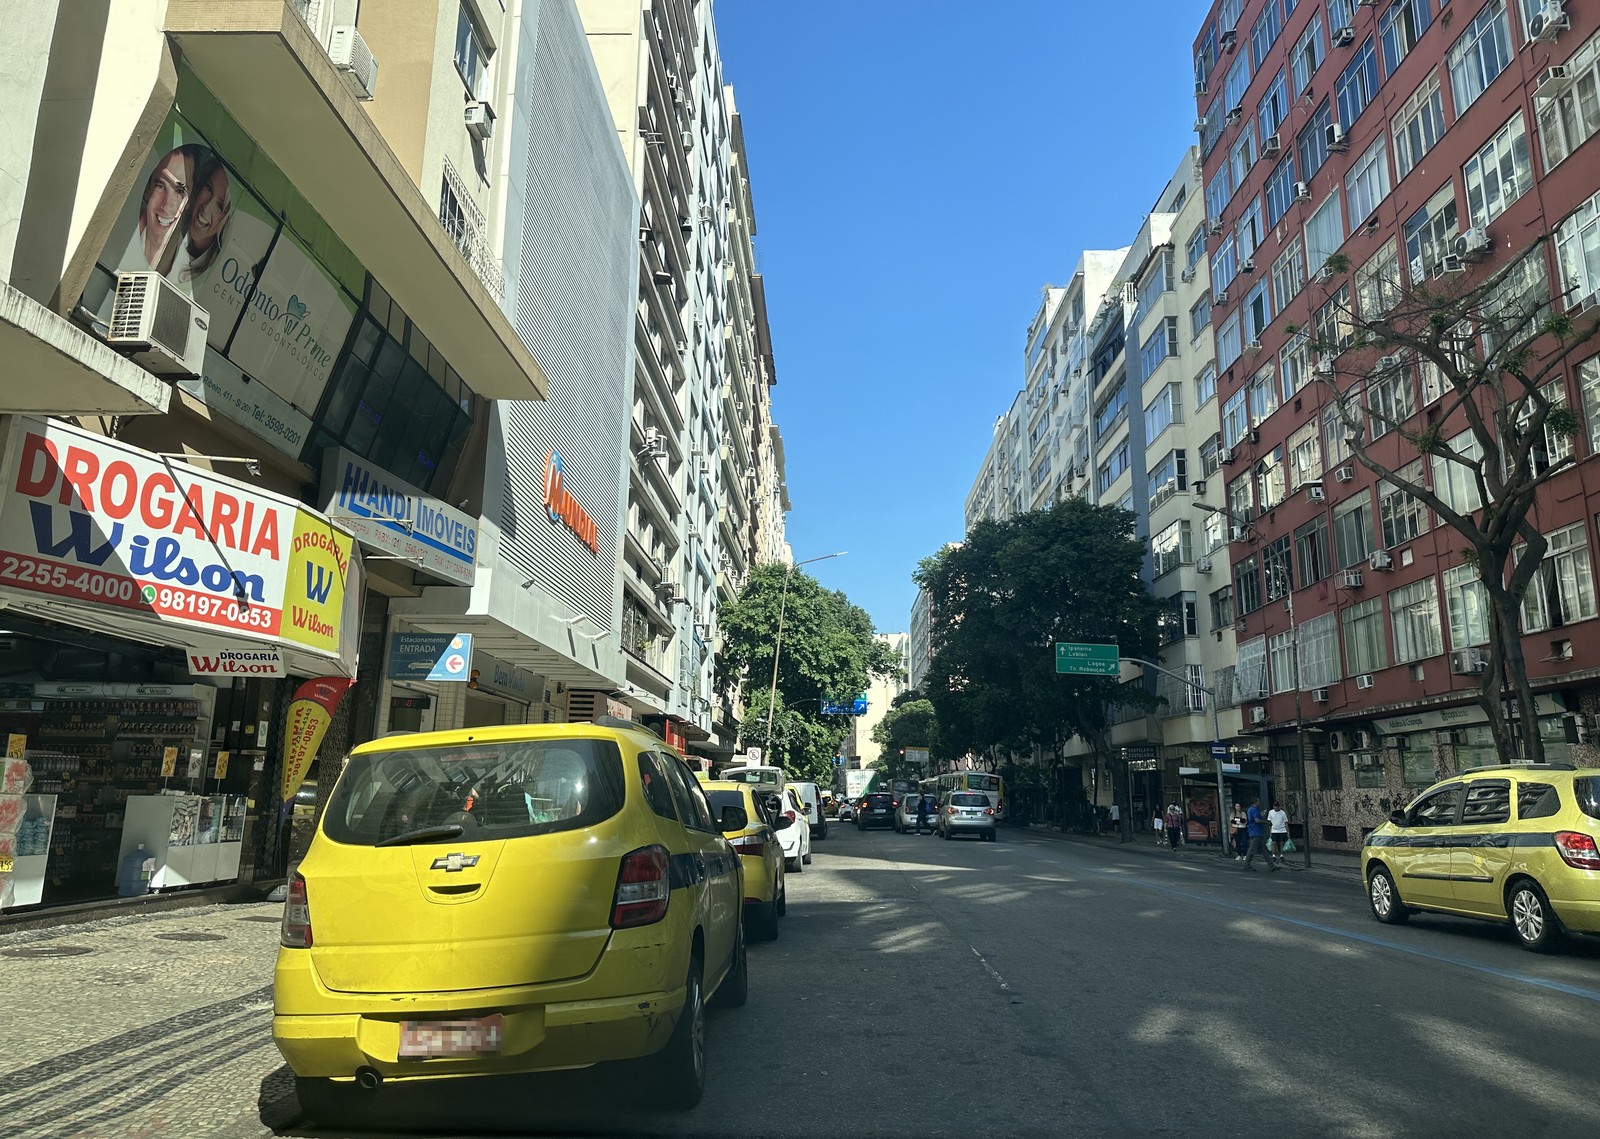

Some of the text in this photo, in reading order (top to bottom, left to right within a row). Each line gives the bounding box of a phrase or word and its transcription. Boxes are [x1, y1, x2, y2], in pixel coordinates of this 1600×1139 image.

[222, 258, 280, 321] Odonto
[203, 376, 222, 396] Ribeiro,
[222, 391, 232, 402] 411
[241, 403, 251, 413] 201
[252, 404, 266, 423] Tel:
[264, 414, 302, 446] 3598-0201
[15, 432, 280, 561] DROGARIA
[28, 500, 265, 603] Wilson
[294, 530, 348, 576] DROGARIA
[416, 497, 476, 554] IMÓVEIS
[1, 556, 272, 628] 2255-4000 98197-0853
[306, 560, 333, 605] W
[292, 605, 334, 639] Wilson
[400, 645, 436, 653] ENTRADA
[190, 655, 278, 674] Wilson
[220, 652, 280, 662] DROGARIA
[292, 718, 318, 776] 98197-0853
